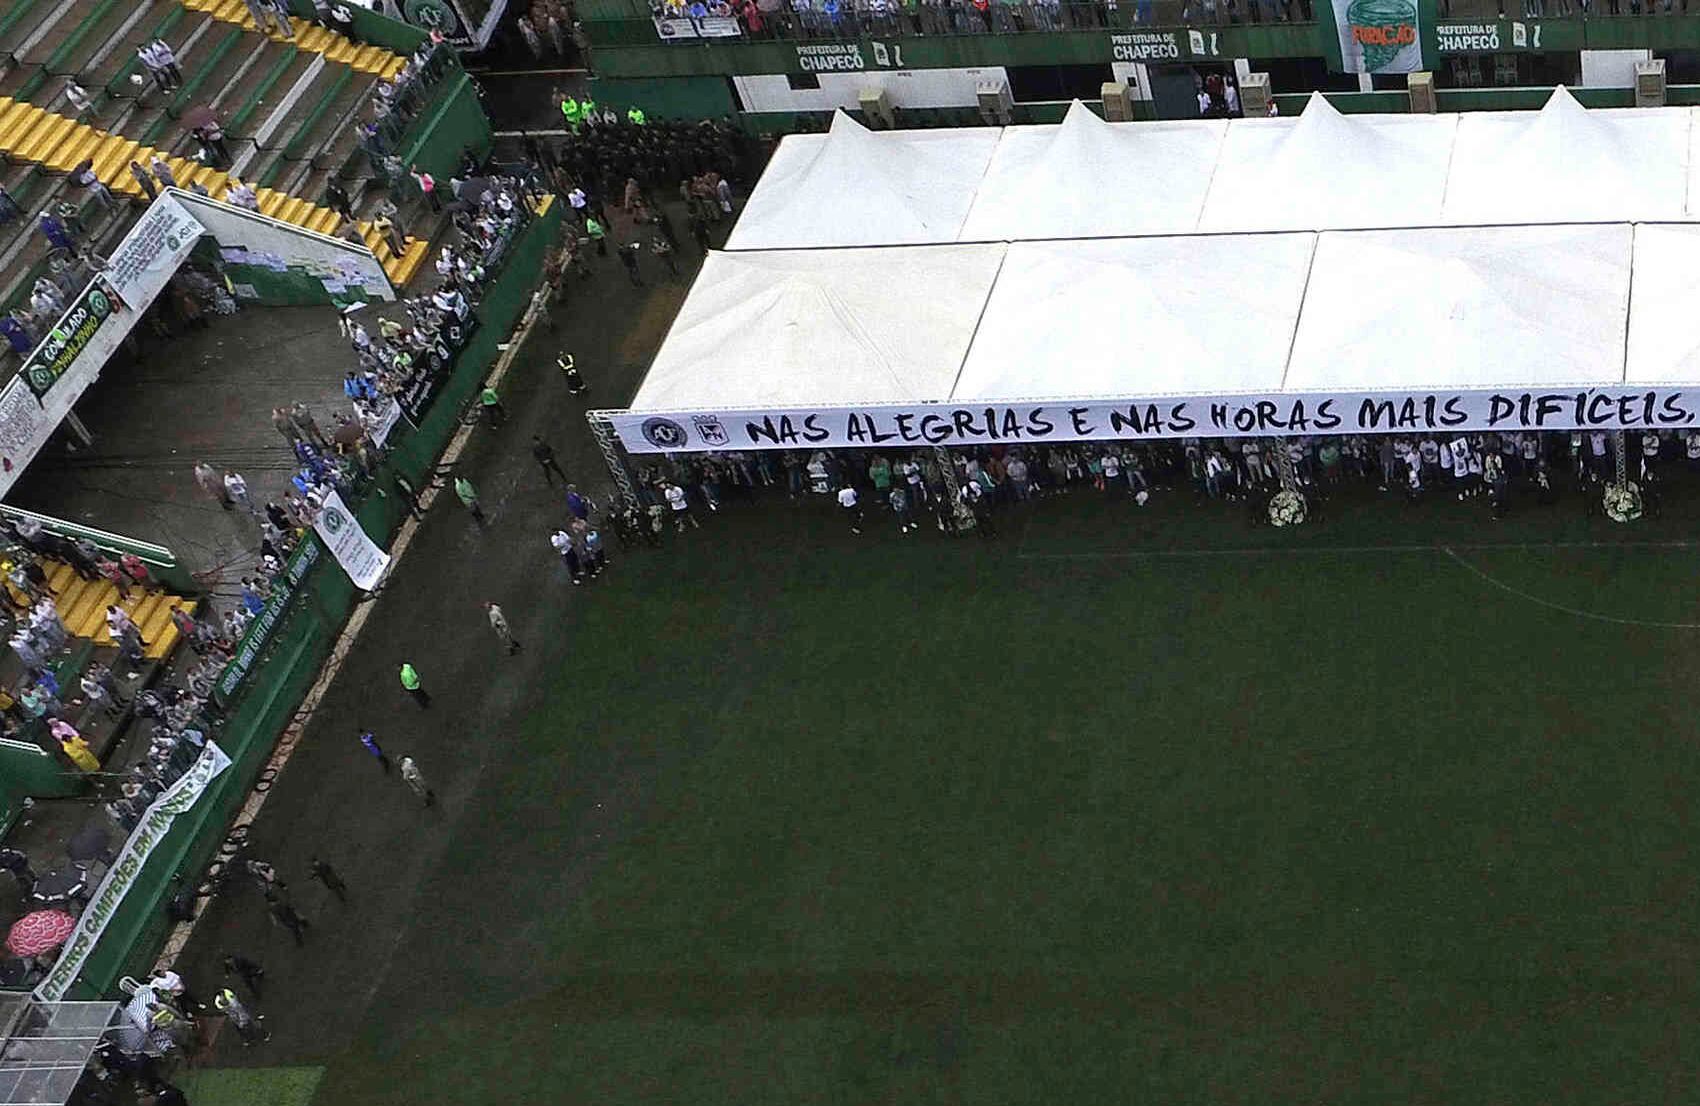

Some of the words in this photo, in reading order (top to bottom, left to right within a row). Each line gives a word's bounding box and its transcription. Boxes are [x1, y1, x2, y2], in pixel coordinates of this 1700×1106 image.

[1486, 25, 1498, 34] DE
[1112, 34, 1162, 44] PREFEITURA
[1163, 33, 1176, 44] DE
[797, 45, 847, 56] PREFEITURA
[1113, 43, 1179, 60] CHAPECÓ
[800, 53, 865, 71] CHAPECÓ
[746, 413, 830, 444] NAS
[847, 407, 1055, 443] ALEGRIAS
[1068, 407, 1096, 433] E
[1111, 402, 1196, 434] NAS
[1211, 398, 1342, 432] HORAS
[1357, 394, 1468, 430] MAIS
